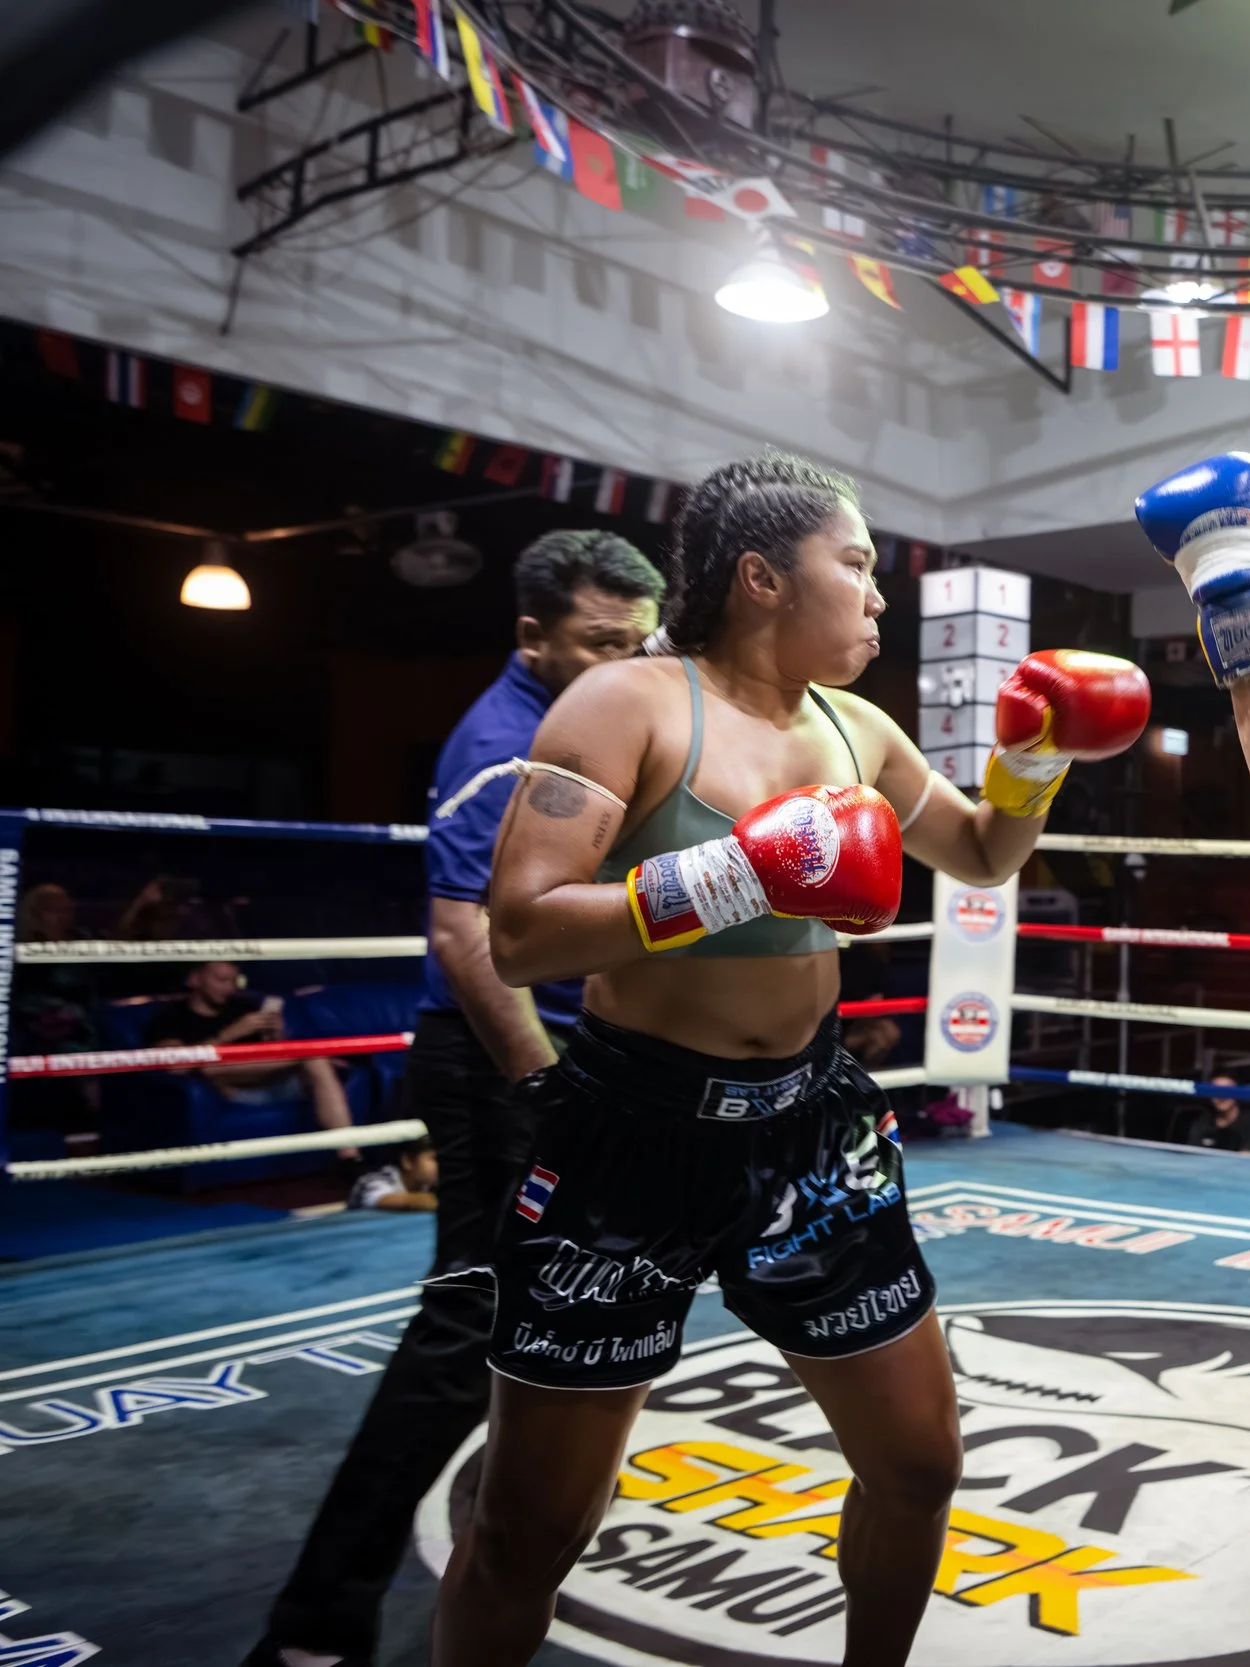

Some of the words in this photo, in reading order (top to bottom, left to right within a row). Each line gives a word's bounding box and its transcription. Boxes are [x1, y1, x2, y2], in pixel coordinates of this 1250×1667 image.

[747, 1213, 834, 1270] FIGHT
[843, 1182, 902, 1223] LAB
[942, 1203, 1196, 1254] SAMUI
[0, 1359, 269, 1455] UAY
